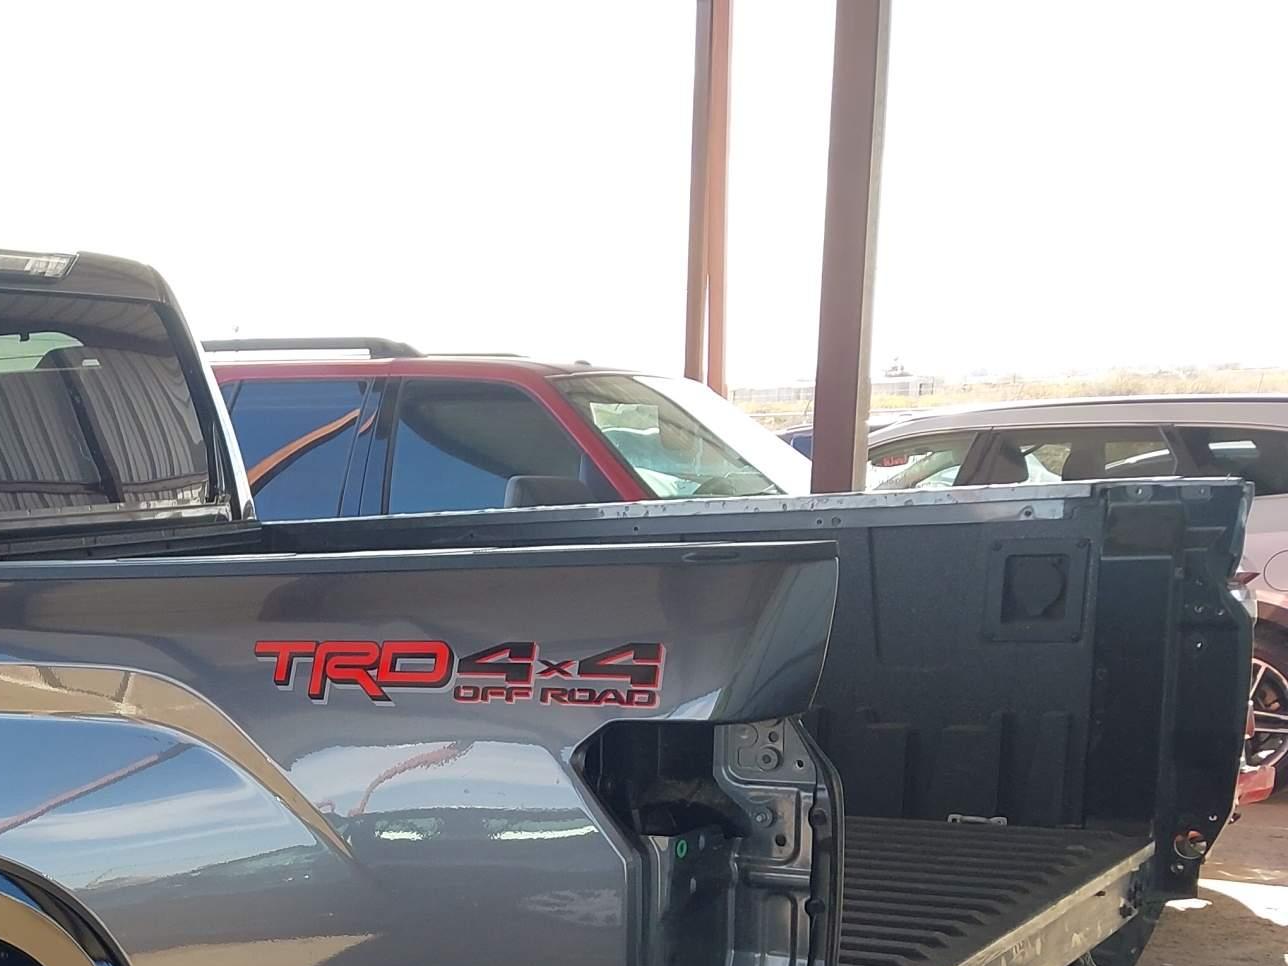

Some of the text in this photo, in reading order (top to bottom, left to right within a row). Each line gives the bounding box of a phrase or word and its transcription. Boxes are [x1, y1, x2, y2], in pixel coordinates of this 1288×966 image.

[254, 640, 454, 706] TRD
[457, 642, 666, 689] 4x4
[453, 686, 661, 708] OFF ROAD
